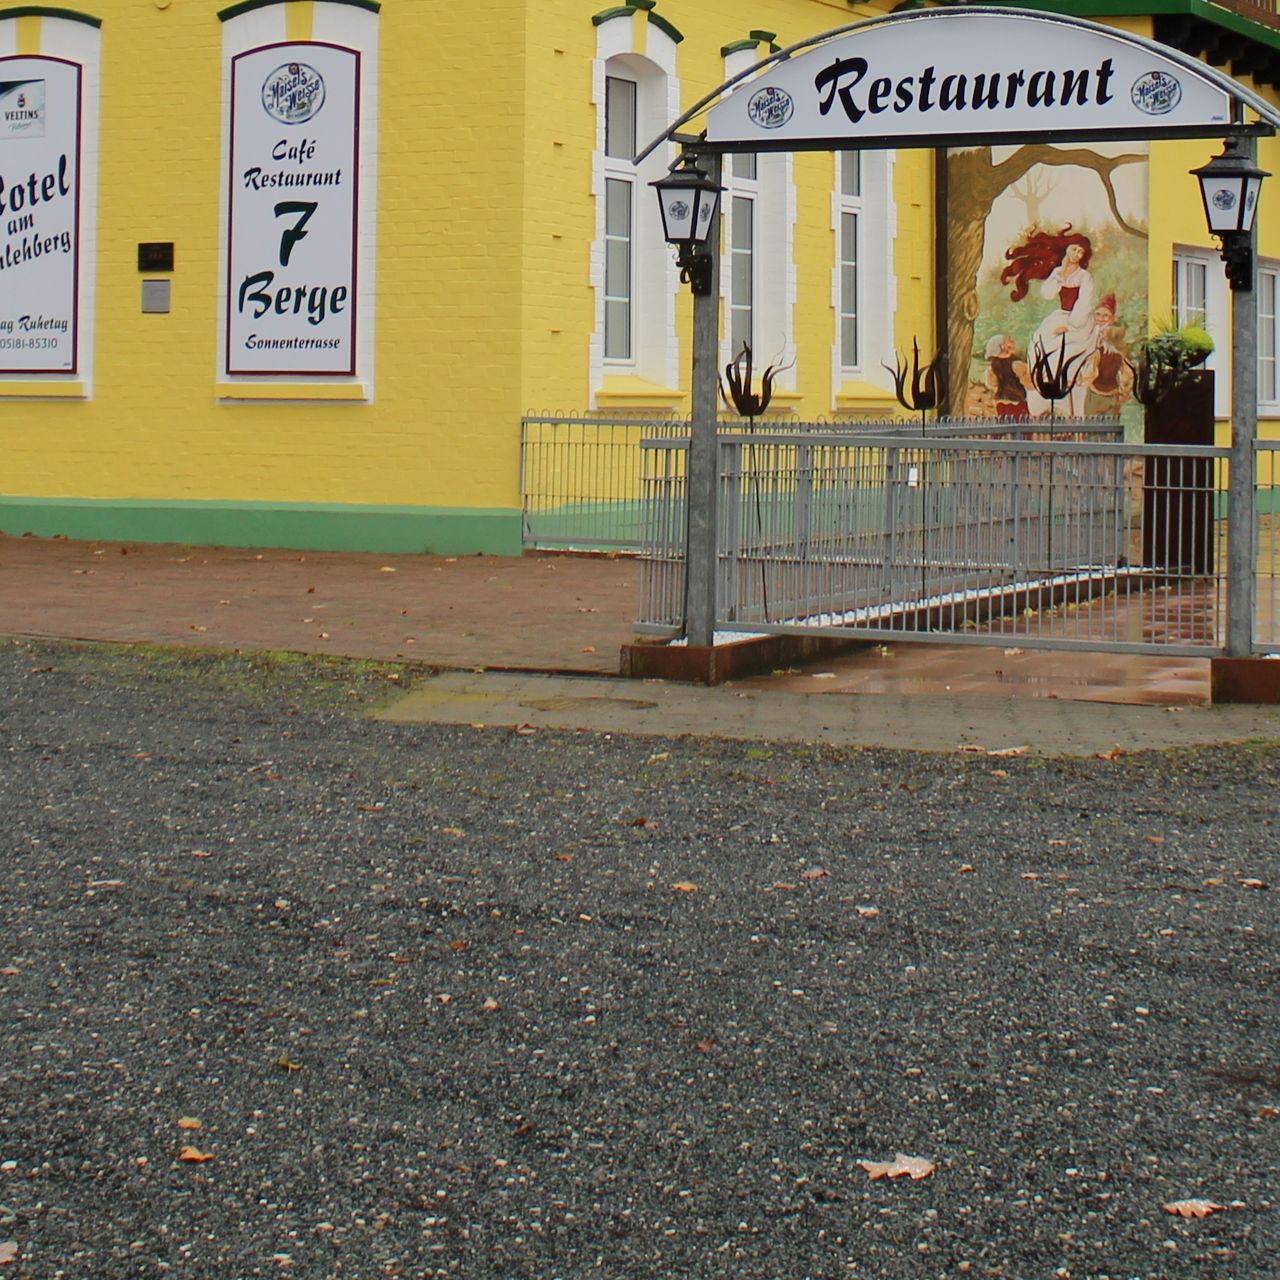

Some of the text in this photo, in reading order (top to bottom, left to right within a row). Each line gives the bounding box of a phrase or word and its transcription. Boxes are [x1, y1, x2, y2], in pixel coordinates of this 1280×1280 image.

[285, 79, 321, 111] Weisse
[814, 57, 1114, 124] Restaurant
[4, 110, 39, 121] VELTINS
[272, 139, 316, 164] Café
[243, 167, 342, 191] Restaurant
[7, 213, 34, 236] am
[274, 201, 318, 267] 7
[238, 270, 347, 326] Berge
[18, 315, 68, 333] Ruhetag
[0, 337, 58, 350] 05181-85310
[245, 333, 340, 350] Sonnenterrasse
